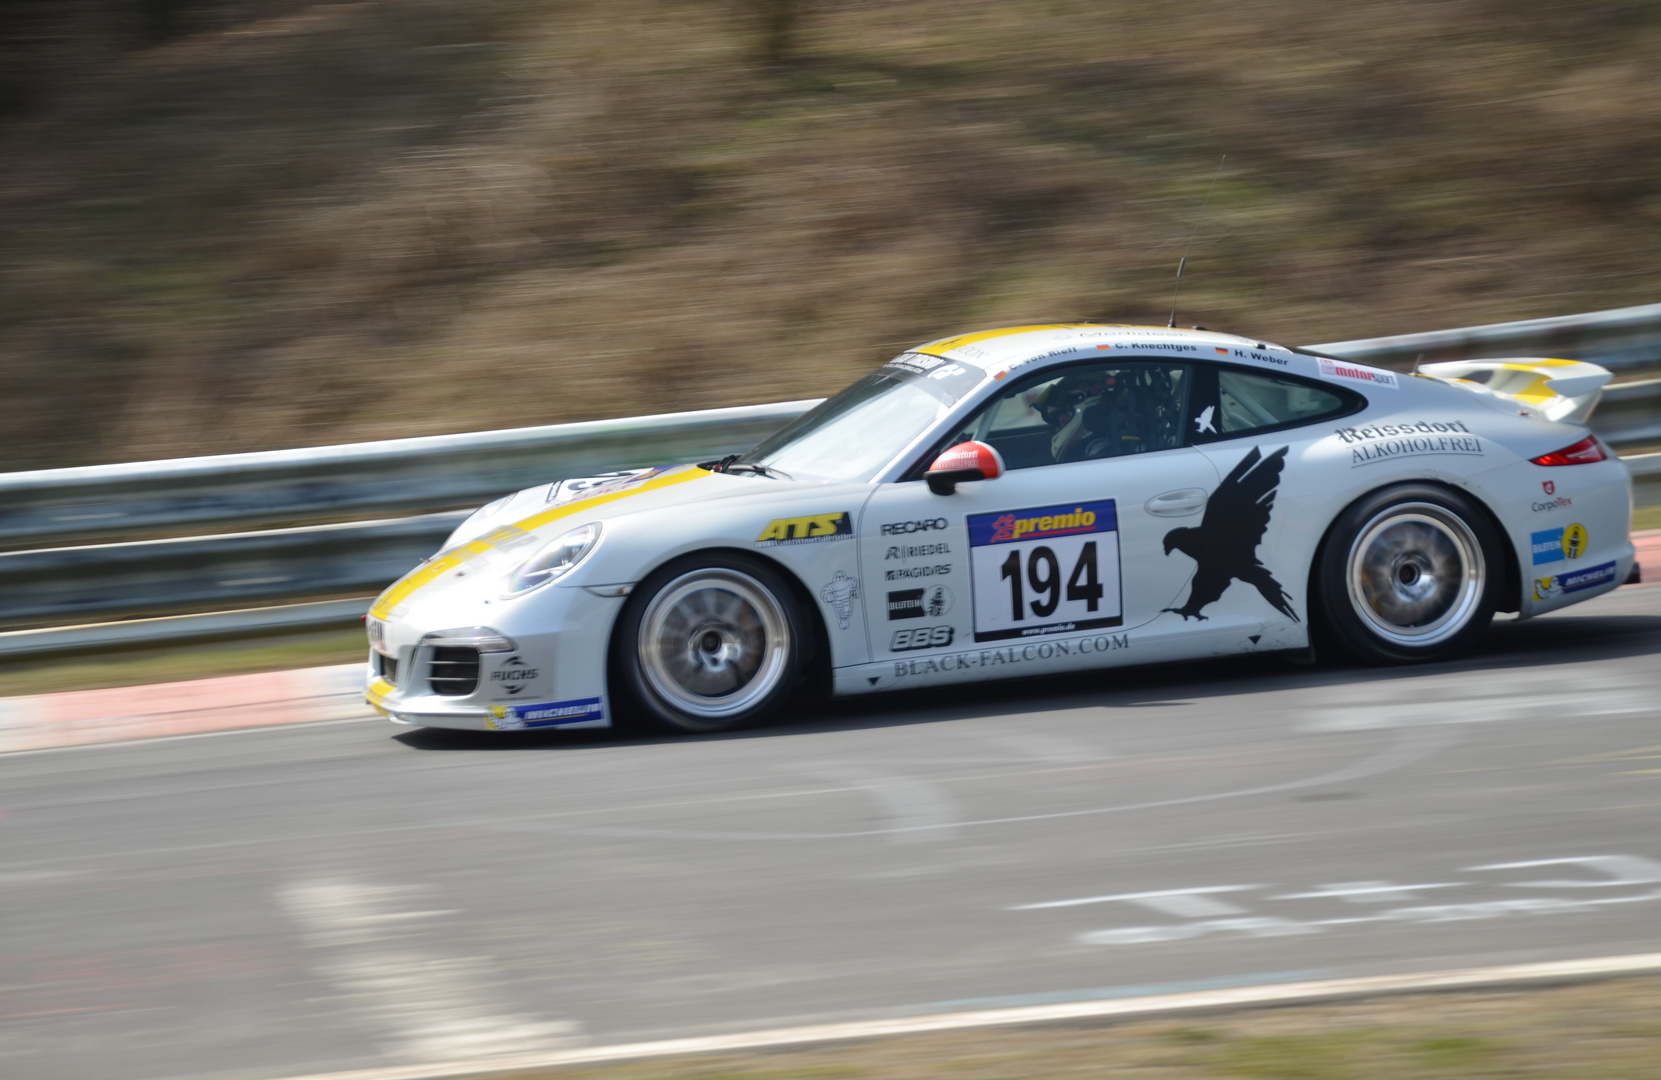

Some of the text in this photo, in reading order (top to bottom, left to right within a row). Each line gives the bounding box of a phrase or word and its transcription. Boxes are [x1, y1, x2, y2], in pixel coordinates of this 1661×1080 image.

[1115, 342, 1197, 352] C. Knechtges
[1024, 354, 1045, 364] von
[1234, 349, 1289, 366] H. Weber
[1335, 420, 1470, 444] Reissdorf
[1352, 437, 1484, 463] ALKOHOLFREI
[1531, 497, 1572, 512] CorpoTex
[756, 512, 844, 541] ATS
[880, 517, 949, 537] RECARO
[1012, 508, 1096, 539] premio
[907, 543, 953, 558] RIEDEL
[1533, 540, 1561, 554] BILSTEIN
[1001, 541, 1104, 621] 194
[1565, 566, 1615, 587] MICHELIN
[889, 625, 955, 652] BBS
[894, 634, 1130, 678] BLACK-FALCON.COM
[490, 668, 540, 681] FUCHS
[524, 702, 602, 720] MICHELIN
